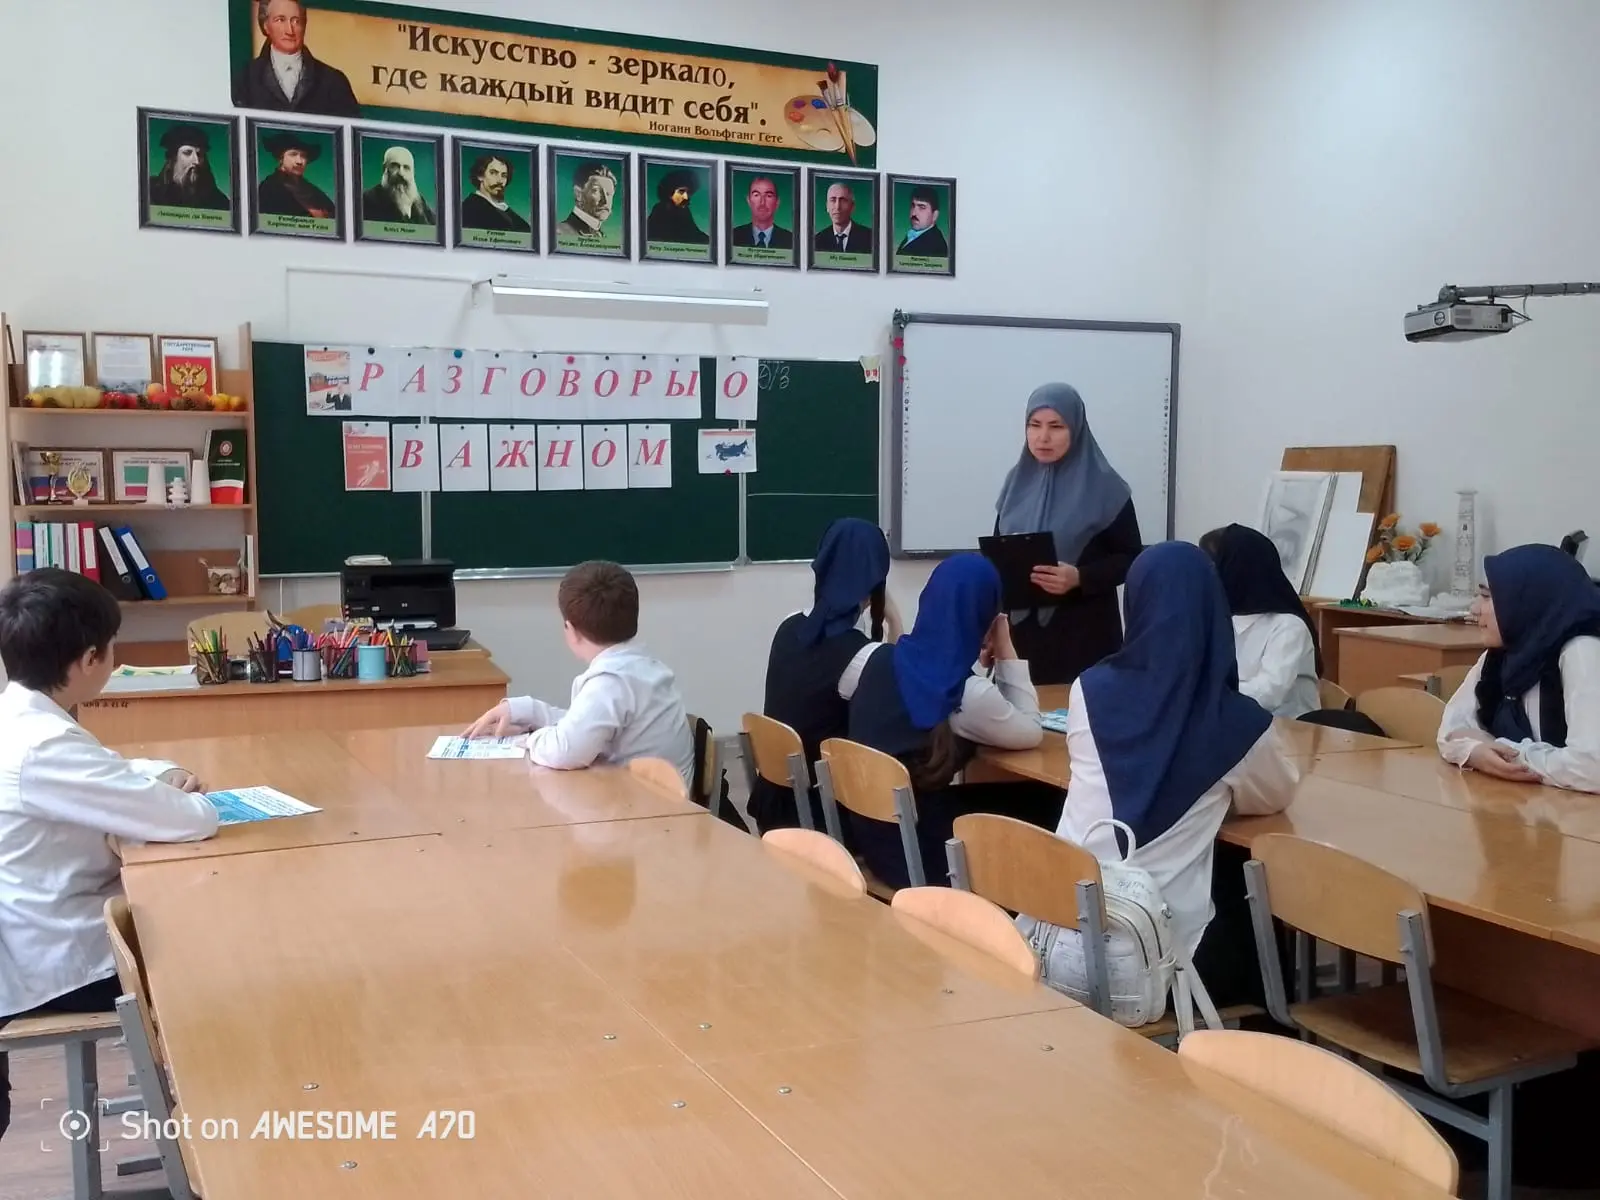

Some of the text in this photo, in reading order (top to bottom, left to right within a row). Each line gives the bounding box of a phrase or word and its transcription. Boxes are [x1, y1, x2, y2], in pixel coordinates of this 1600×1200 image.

[398, 24, 577, 69] "Искусство
[607, 55, 735, 89] зеркало,
[371, 65, 767, 126] где каждый видит себя".
[649, 121, 691, 134] Иоганн
[694, 126, 756, 141] Вольфганг
[358, 362, 748, 398] РАЗГОВОРЫ О
[399, 438, 670, 469] ВАЖНОМ
